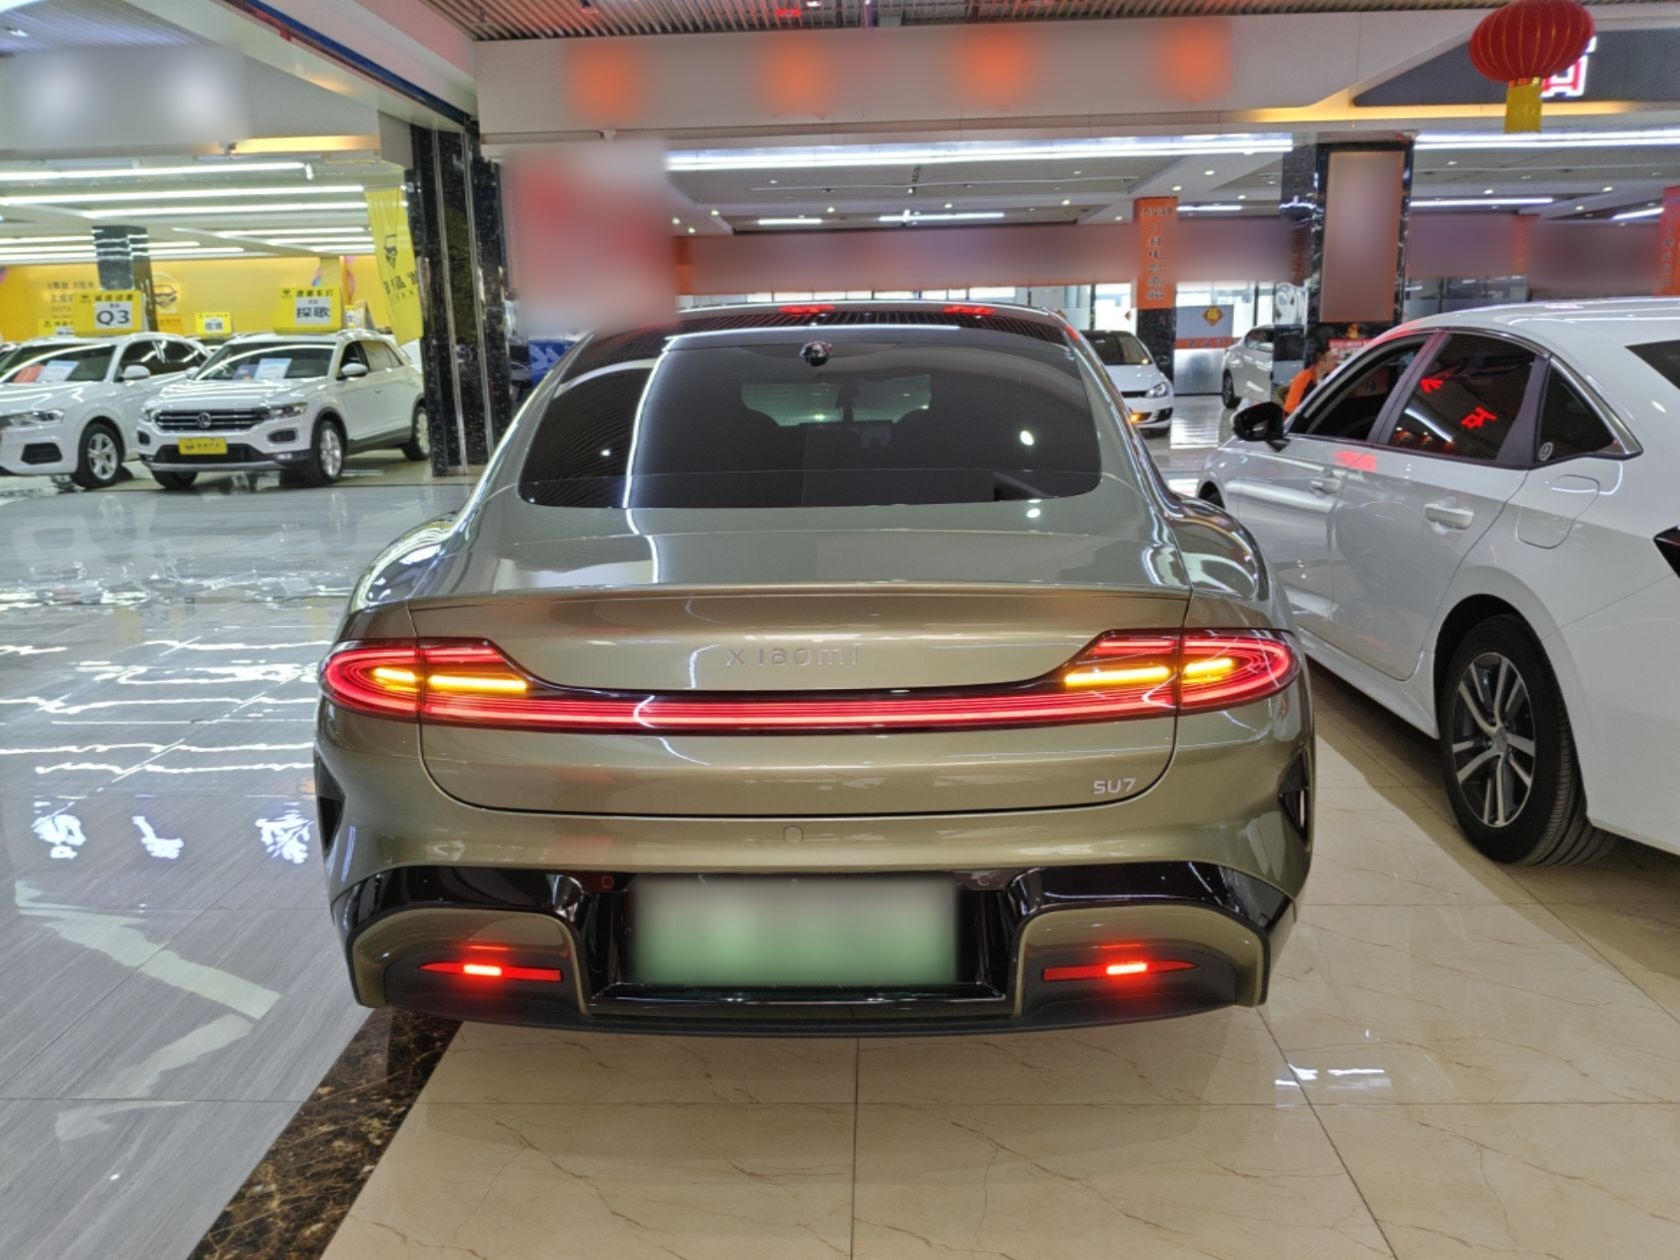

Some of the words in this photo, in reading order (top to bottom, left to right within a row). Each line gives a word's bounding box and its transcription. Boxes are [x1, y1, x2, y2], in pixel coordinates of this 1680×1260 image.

[96, 310, 130, 326] Q3
[725, 647, 859, 666] xiaomi
[1093, 778, 1136, 794] SU7
